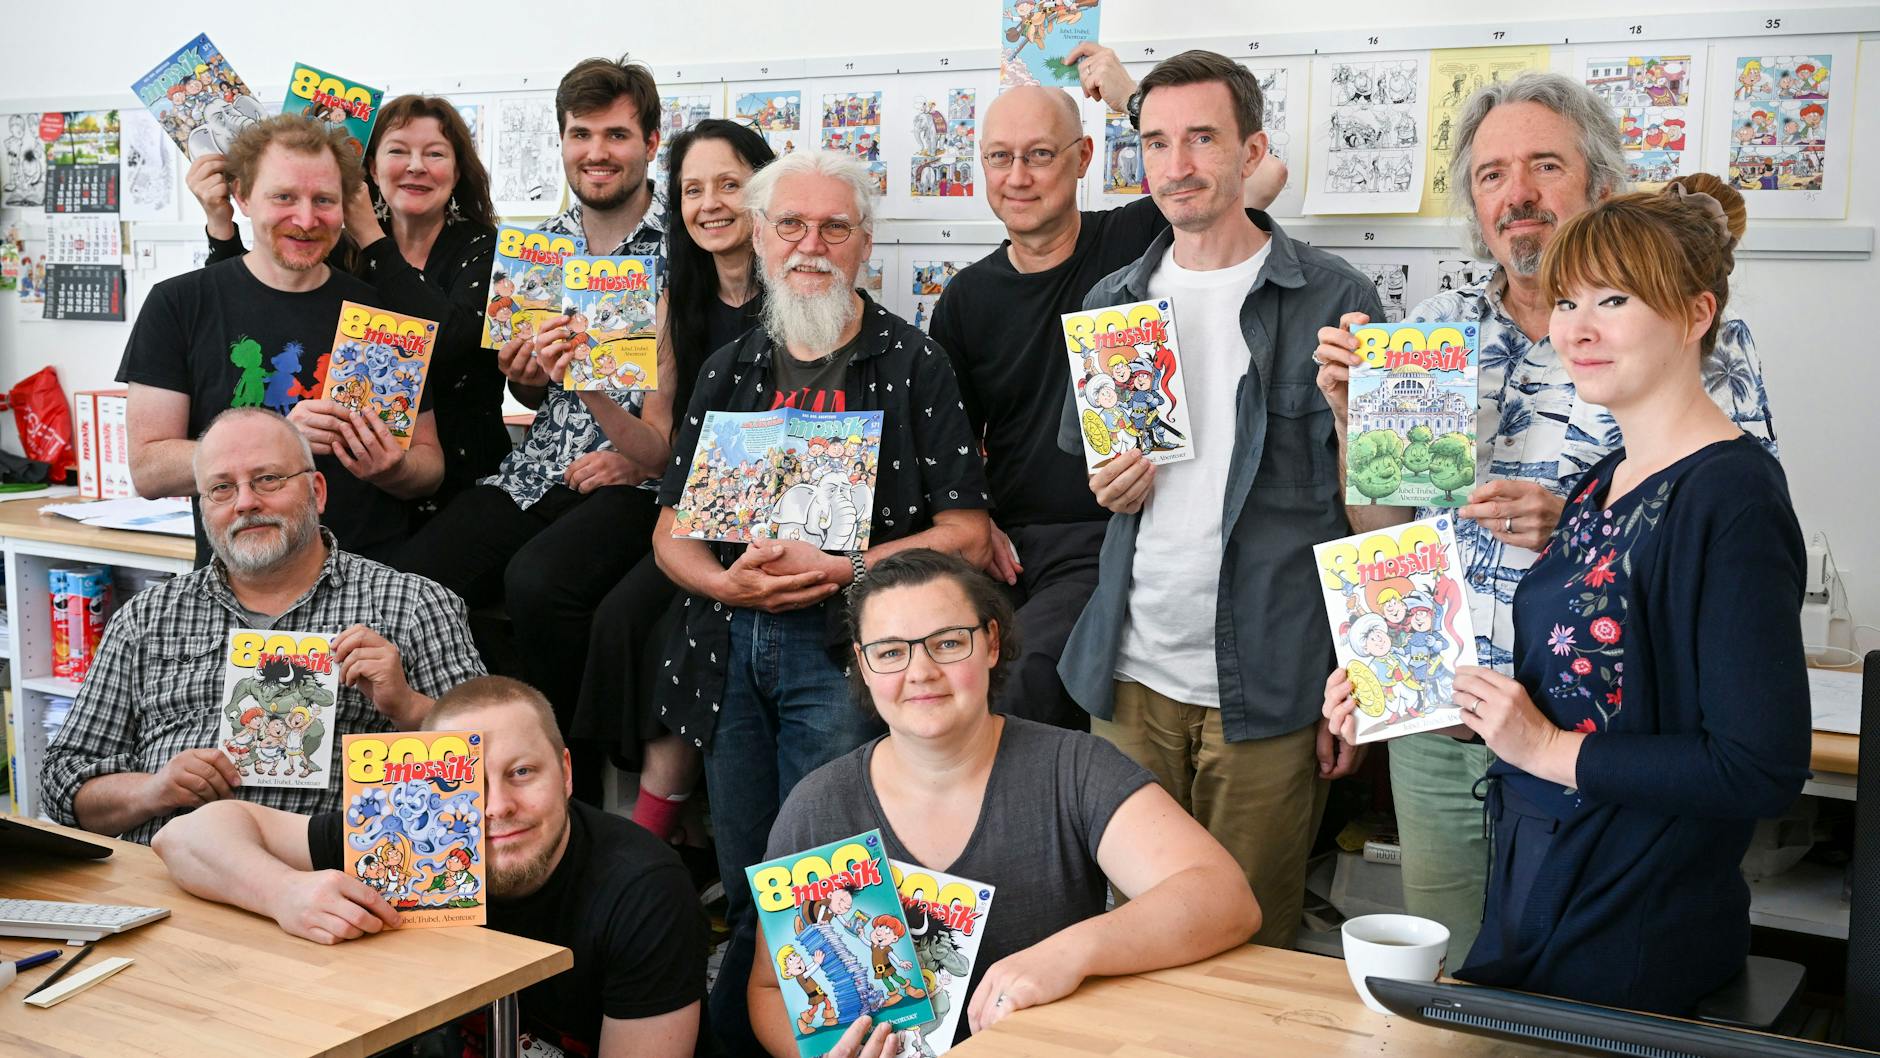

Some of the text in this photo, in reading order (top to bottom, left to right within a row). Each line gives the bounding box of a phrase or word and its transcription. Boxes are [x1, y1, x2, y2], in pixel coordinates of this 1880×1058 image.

[1493, 31, 1506, 40] 17
[1629, 25, 1643, 35] 18
[1764, 18, 1782, 29] 35
[1144, 47, 1156, 56] 14
[1248, 42, 1260, 51] 15
[1367, 36, 1379, 46] 16
[760, 67, 769, 75] 10
[845, 62, 854, 71] 11
[939, 57, 950, 66] 12
[291, 68, 372, 106] 800
[312, 89, 376, 123] mosaik
[498, 229, 575, 258] 800
[941, 230, 951, 239] 46
[1364, 232, 1376, 242] 50
[519, 247, 574, 267] mosai
[565, 260, 645, 289] 800
[587, 273, 652, 292] mosaik
[341, 307, 425, 339] 800
[1065, 305, 1162, 353] 800
[1094, 320, 1171, 351] mosaik
[362, 328, 431, 356] mosaik
[1354, 328, 1465, 368] 800
[1383, 346, 1474, 372] mosaik
[788, 416, 869, 442] mosaik
[1356, 543, 1450, 588] mosaik
[230, 633, 330, 668] 800
[348, 736, 470, 783] 800
[383, 755, 479, 784] mosaik
[753, 843, 872, 912] 800
[791, 856, 882, 908] mosaik
[418, 915, 441, 923] Trubel,
[442, 914, 476, 922] Abenteuer
